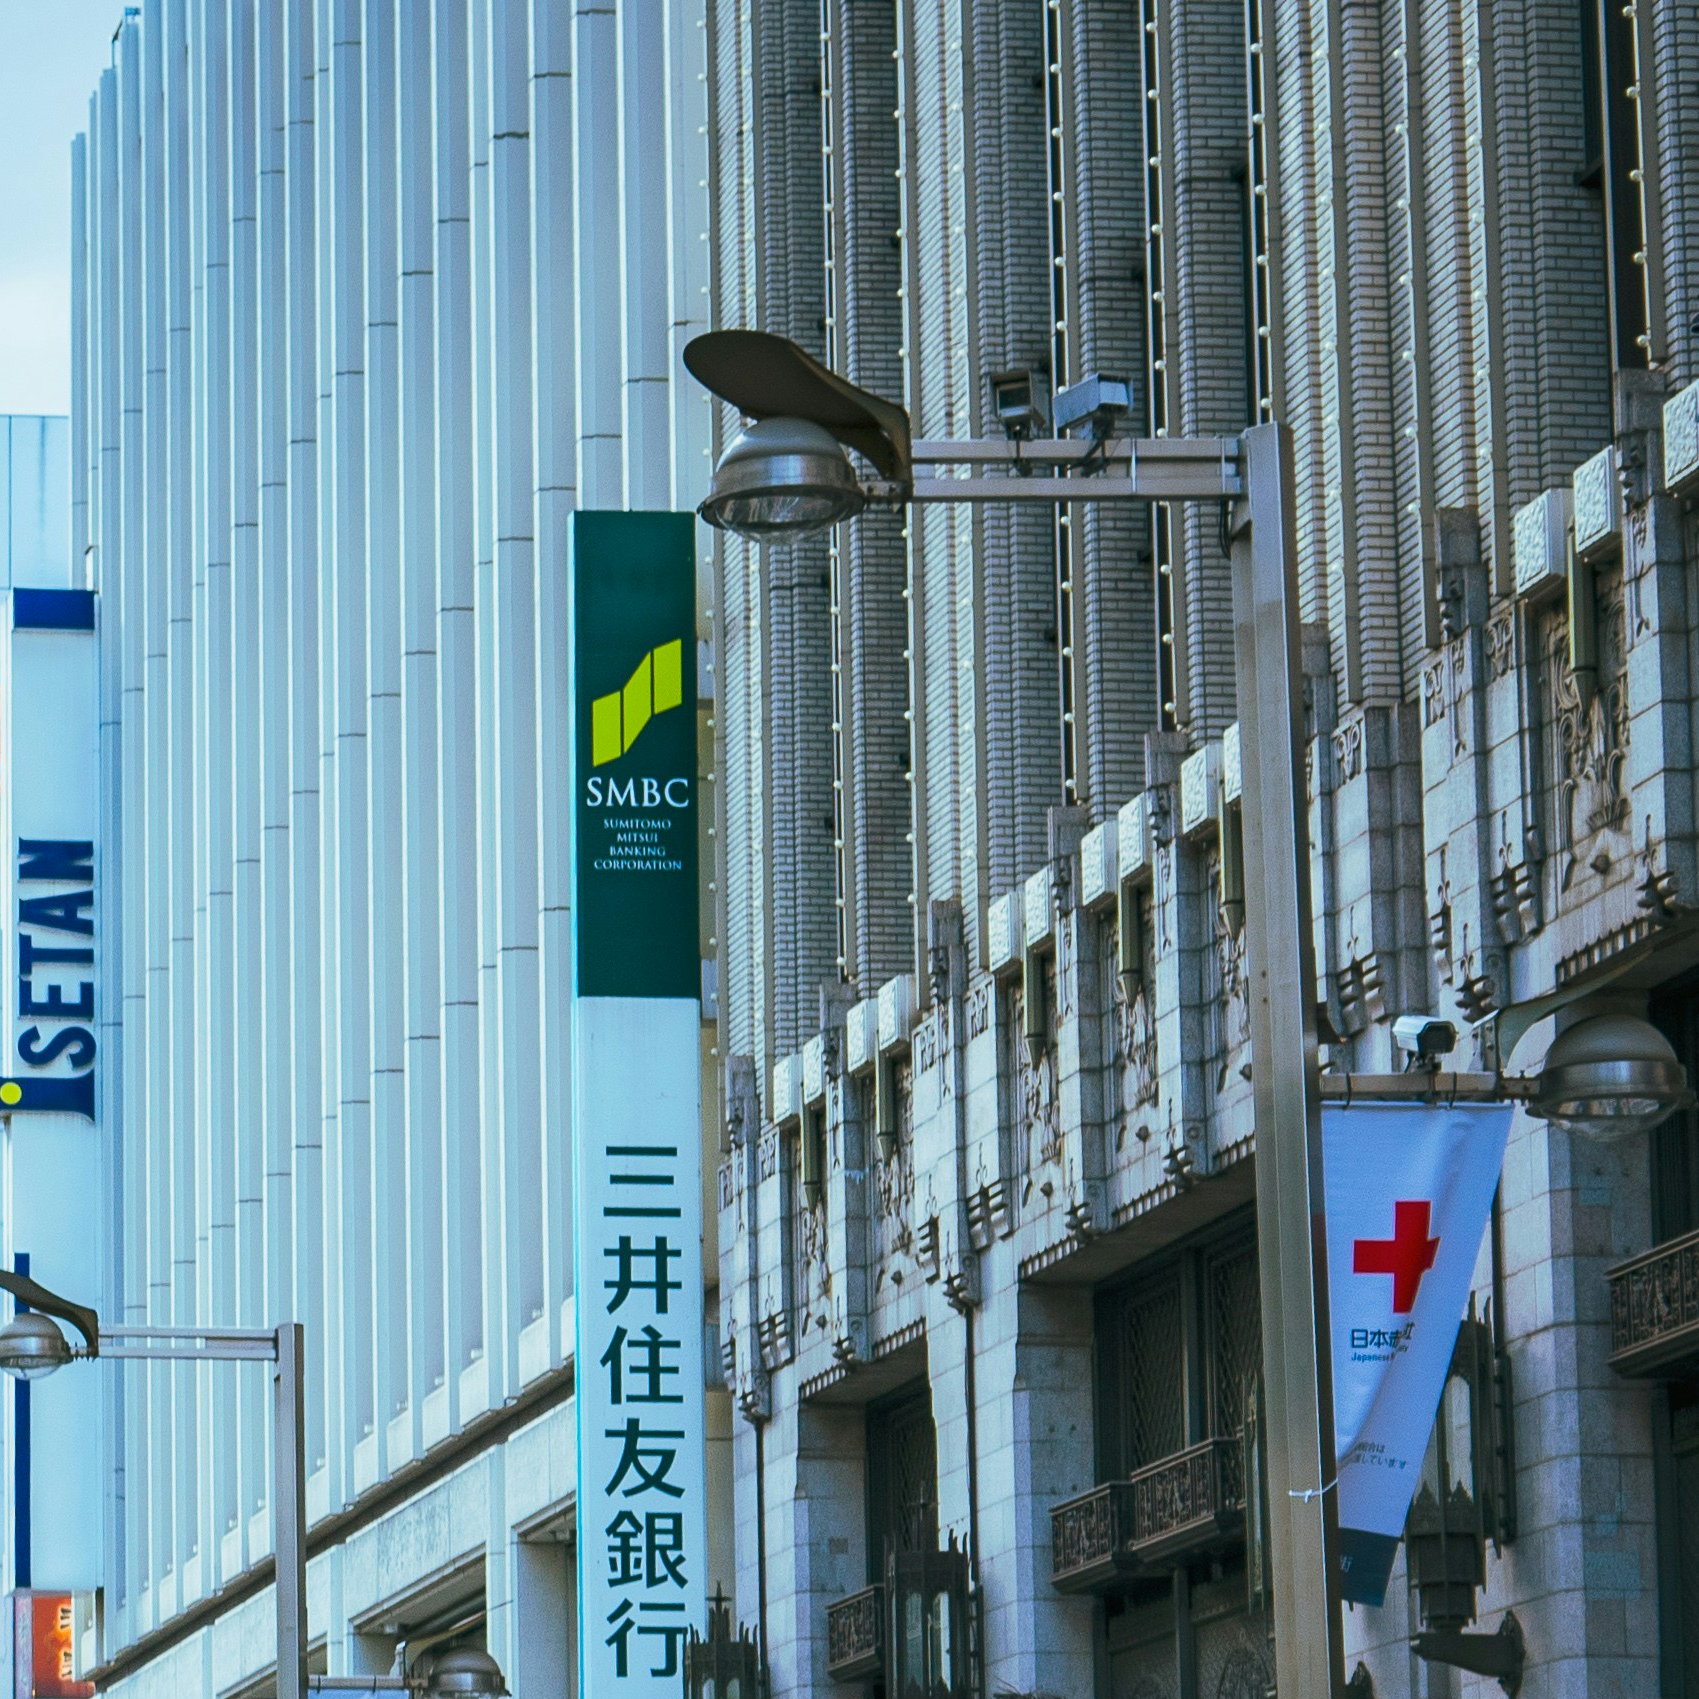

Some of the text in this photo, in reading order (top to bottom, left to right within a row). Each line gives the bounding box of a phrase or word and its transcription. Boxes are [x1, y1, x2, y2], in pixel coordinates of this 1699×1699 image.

[586, 776, 689, 808] SMBC
[604, 818, 672, 829] SUMITOMO
[617, 832, 659, 842] MITSUI
[610, 846, 667, 857] BANKING
[594, 860, 682, 870] CORPORATION
[600, 1146, 688, 1678] 三井住友銀行
